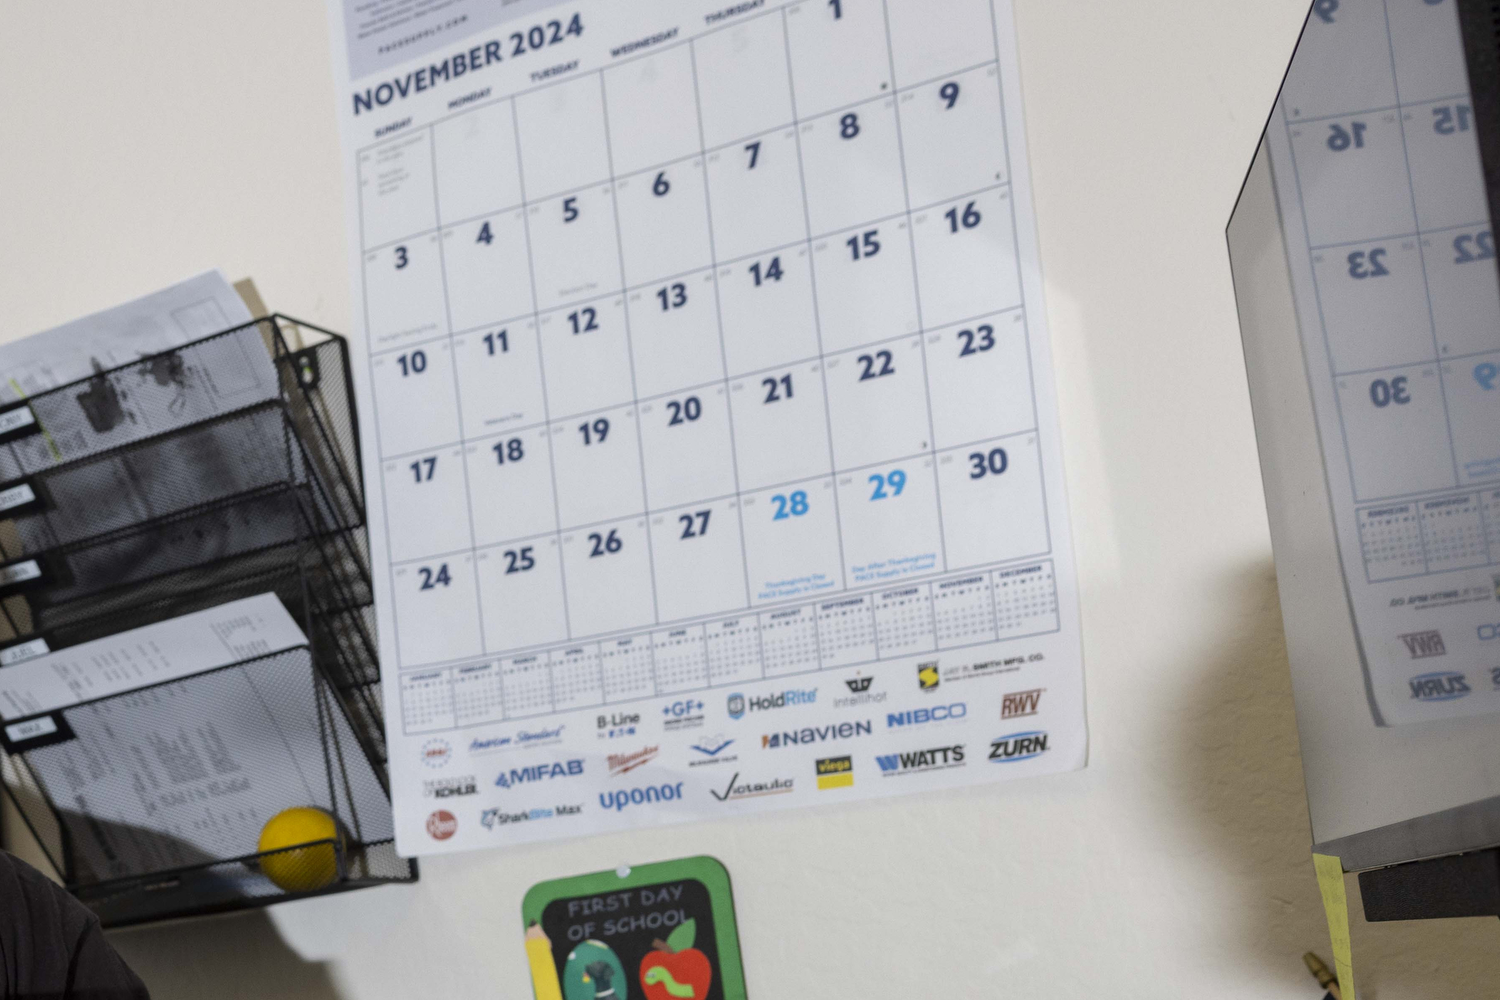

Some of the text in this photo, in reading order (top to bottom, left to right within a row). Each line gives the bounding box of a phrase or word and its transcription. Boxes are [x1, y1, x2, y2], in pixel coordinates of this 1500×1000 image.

[828, 0, 842, 20] 1
[608, 26, 680, 59] WEDNESDAY
[352, 40, 504, 117] NOVEMBER
[508, 12, 585, 59] 2024
[528, 59, 581, 84] TUESDAY
[446, 87, 493, 111] MONDAY
[939, 81, 960, 110] 9
[373, 116, 414, 139] SUNDAY
[839, 112, 861, 140] 8
[744, 141, 761, 169] 7
[652, 171, 671, 197] 6
[563, 196, 579, 223] 5
[944, 201, 982, 234] 16
[476, 221, 494, 245] 4
[846, 229, 881, 261] 15
[395, 245, 409, 270] 3
[748, 256, 784, 287] 14
[656, 282, 688, 311] 13
[567, 307, 599, 335] 12
[482, 329, 509, 356] 11
[957, 324, 996, 358] 23
[397, 349, 427, 377] 10
[857, 349, 895, 382] 22
[761, 373, 794, 404] 21
[666, 396, 702, 427] 20
[578, 418, 610, 446] 19
[492, 437, 524, 465] 18
[968, 447, 1008, 480] 30
[410, 456, 437, 483] 17
[868, 469, 907, 502] 29
[770, 490, 810, 521] 28
[678, 509, 712, 540] 27
[588, 529, 623, 558] 26
[503, 546, 535, 575] 25
[418, 563, 452, 591] 24
[748, 688, 818, 712] HoldRite
[886, 702, 967, 728] NIBCO
[899, 745, 967, 771] WATTS
[988, 734, 1050, 760] ZURN
[510, 759, 585, 785] MIFAB
[817, 759, 852, 774] viega
[599, 781, 684, 813] uponor
[568, 884, 684, 918] FIRST DAY
[566, 908, 688, 942] OF SCHOOL
